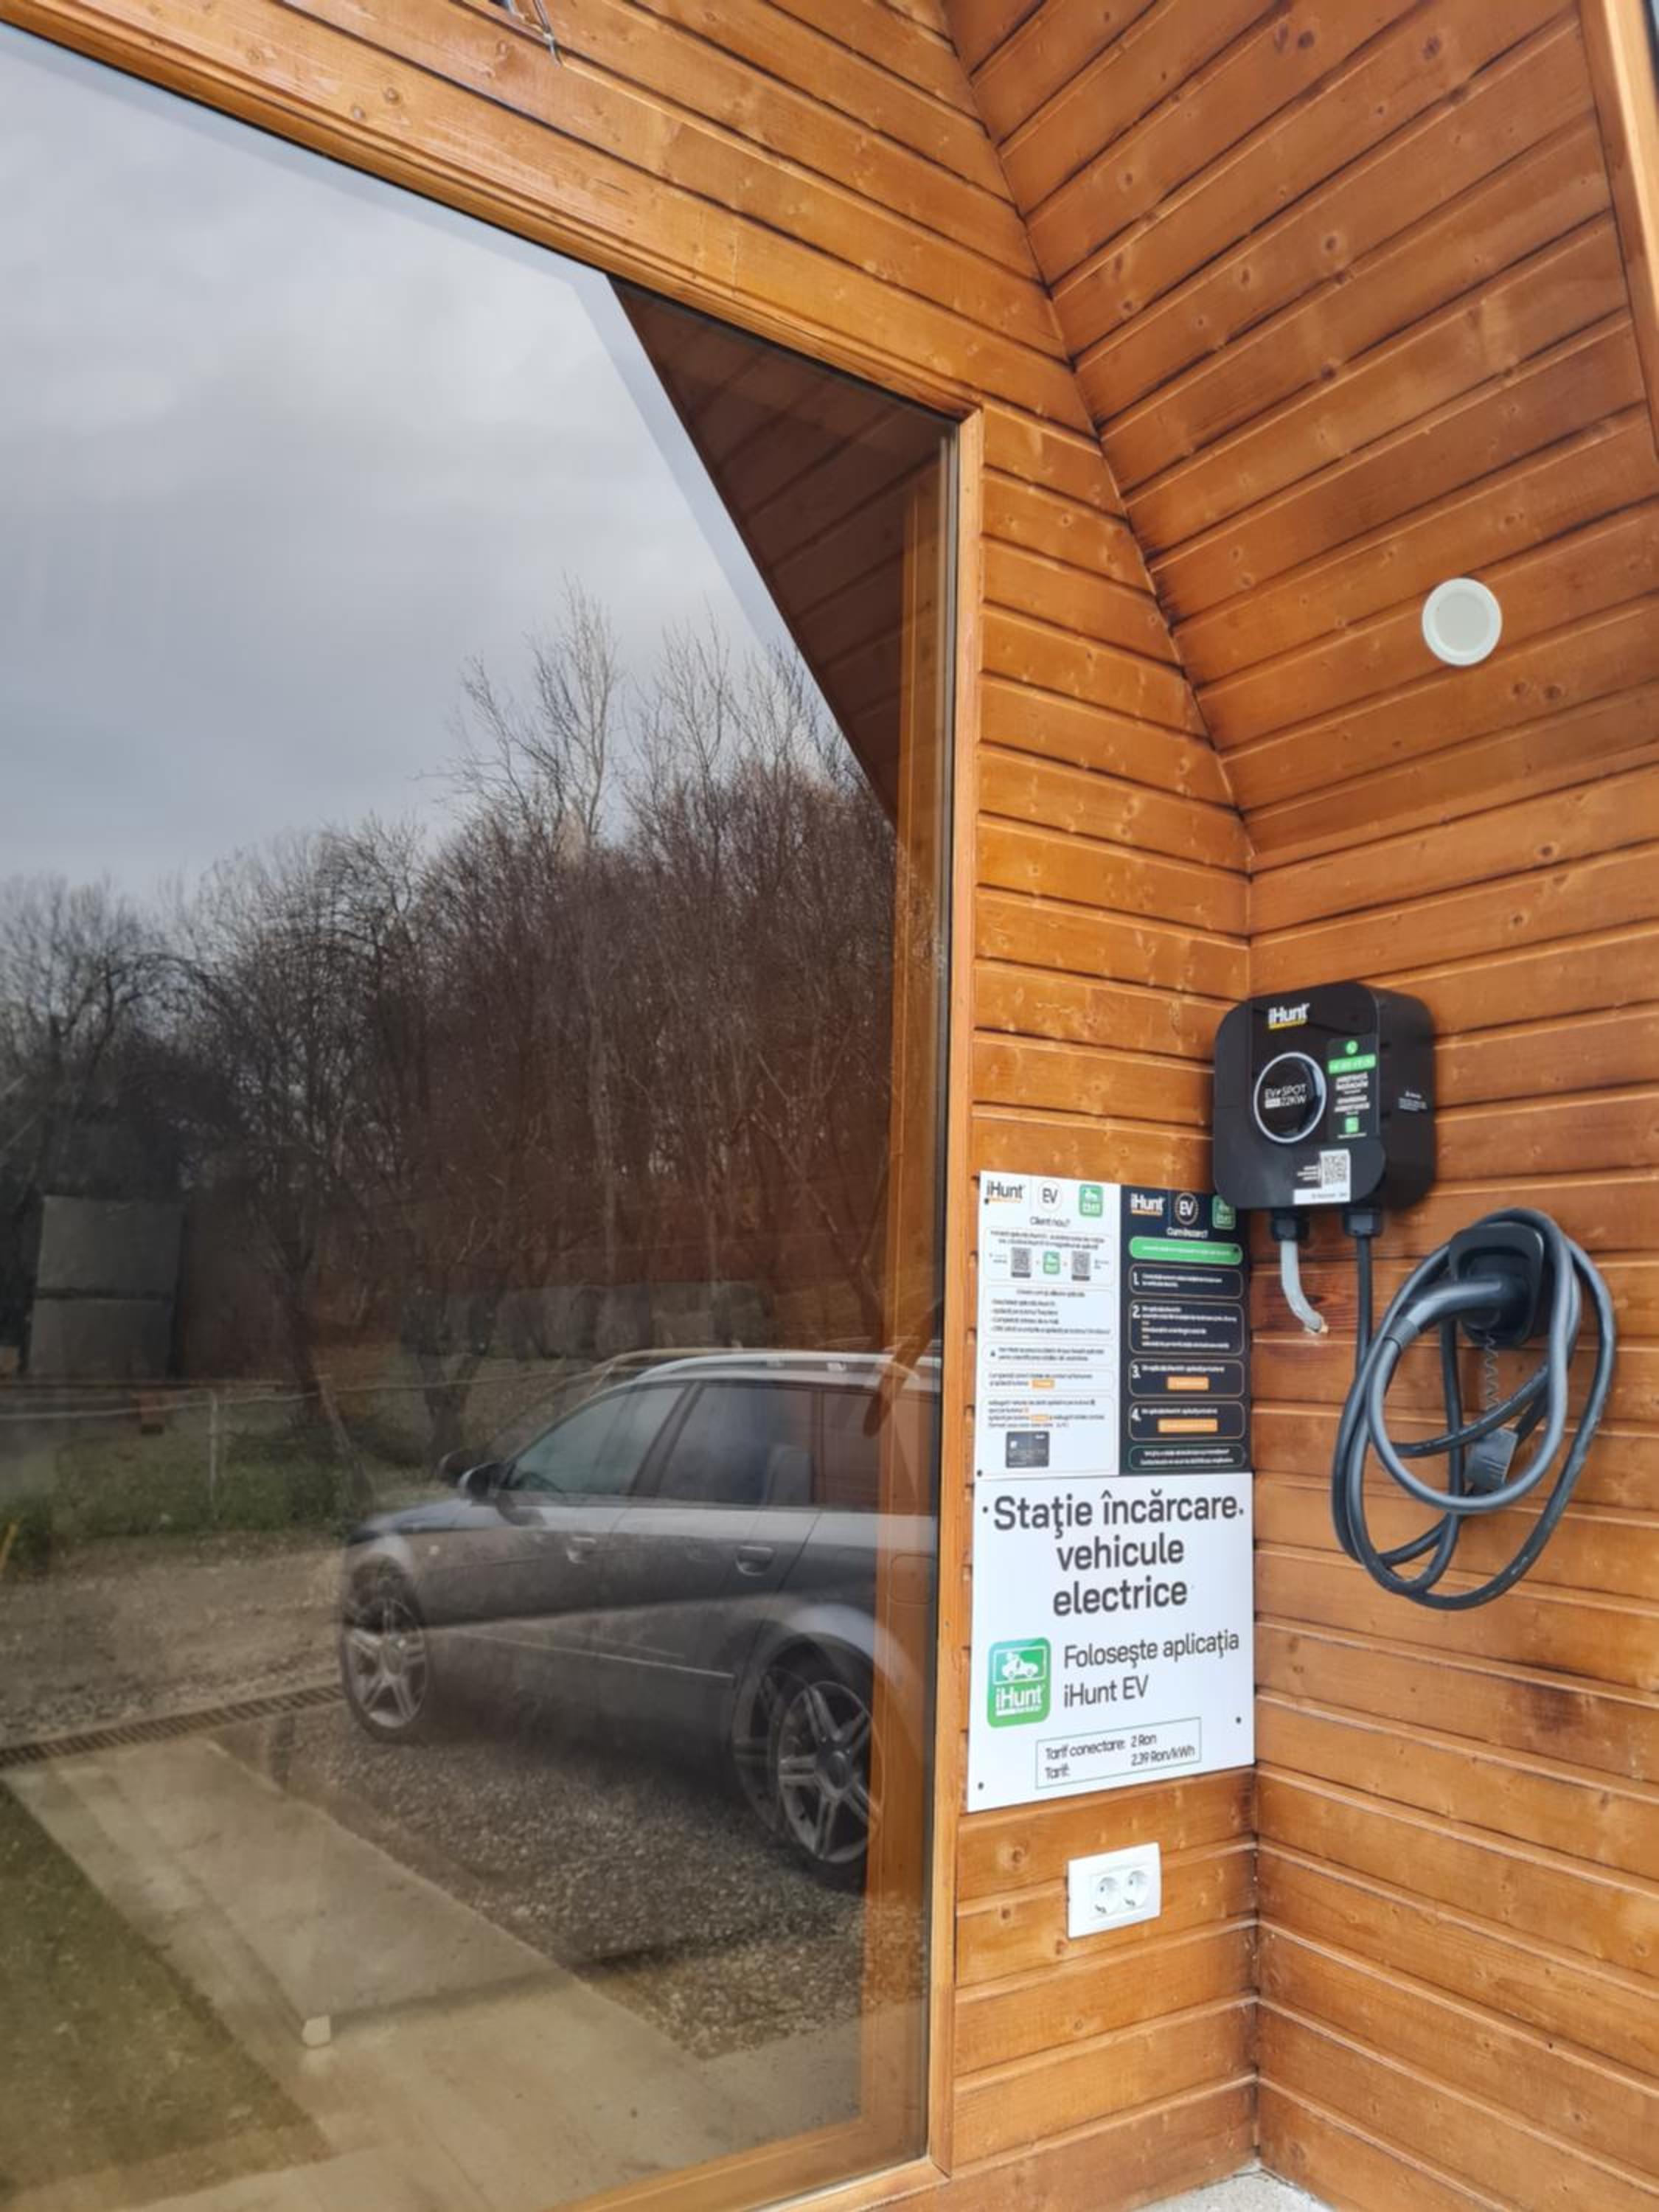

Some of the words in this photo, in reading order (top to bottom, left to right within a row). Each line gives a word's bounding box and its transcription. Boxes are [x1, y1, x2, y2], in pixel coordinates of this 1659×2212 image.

[1268, 1004, 1308, 1026] iHunt
[987, 1180, 1023, 1200] iHunt
[1042, 1188, 1058, 1204] EV
[1130, 1193, 1164, 1213] iHunt
[1180, 1200, 1194, 1216] EV
[1102, 1489, 1237, 1525] încărcare
[1057, 1531, 1184, 1571] vehicule
[1054, 1575, 1187, 1616] electrice
[995, 1685, 1042, 1710] iHunt
[1064, 1680, 1117, 1708] iHunt
[1123, 1674, 1150, 1700] EV
[1046, 1745, 1068, 1760] Tarif
[1131, 1735, 1137, 1748] 2
[1138, 1733, 1157, 1747] Ron
